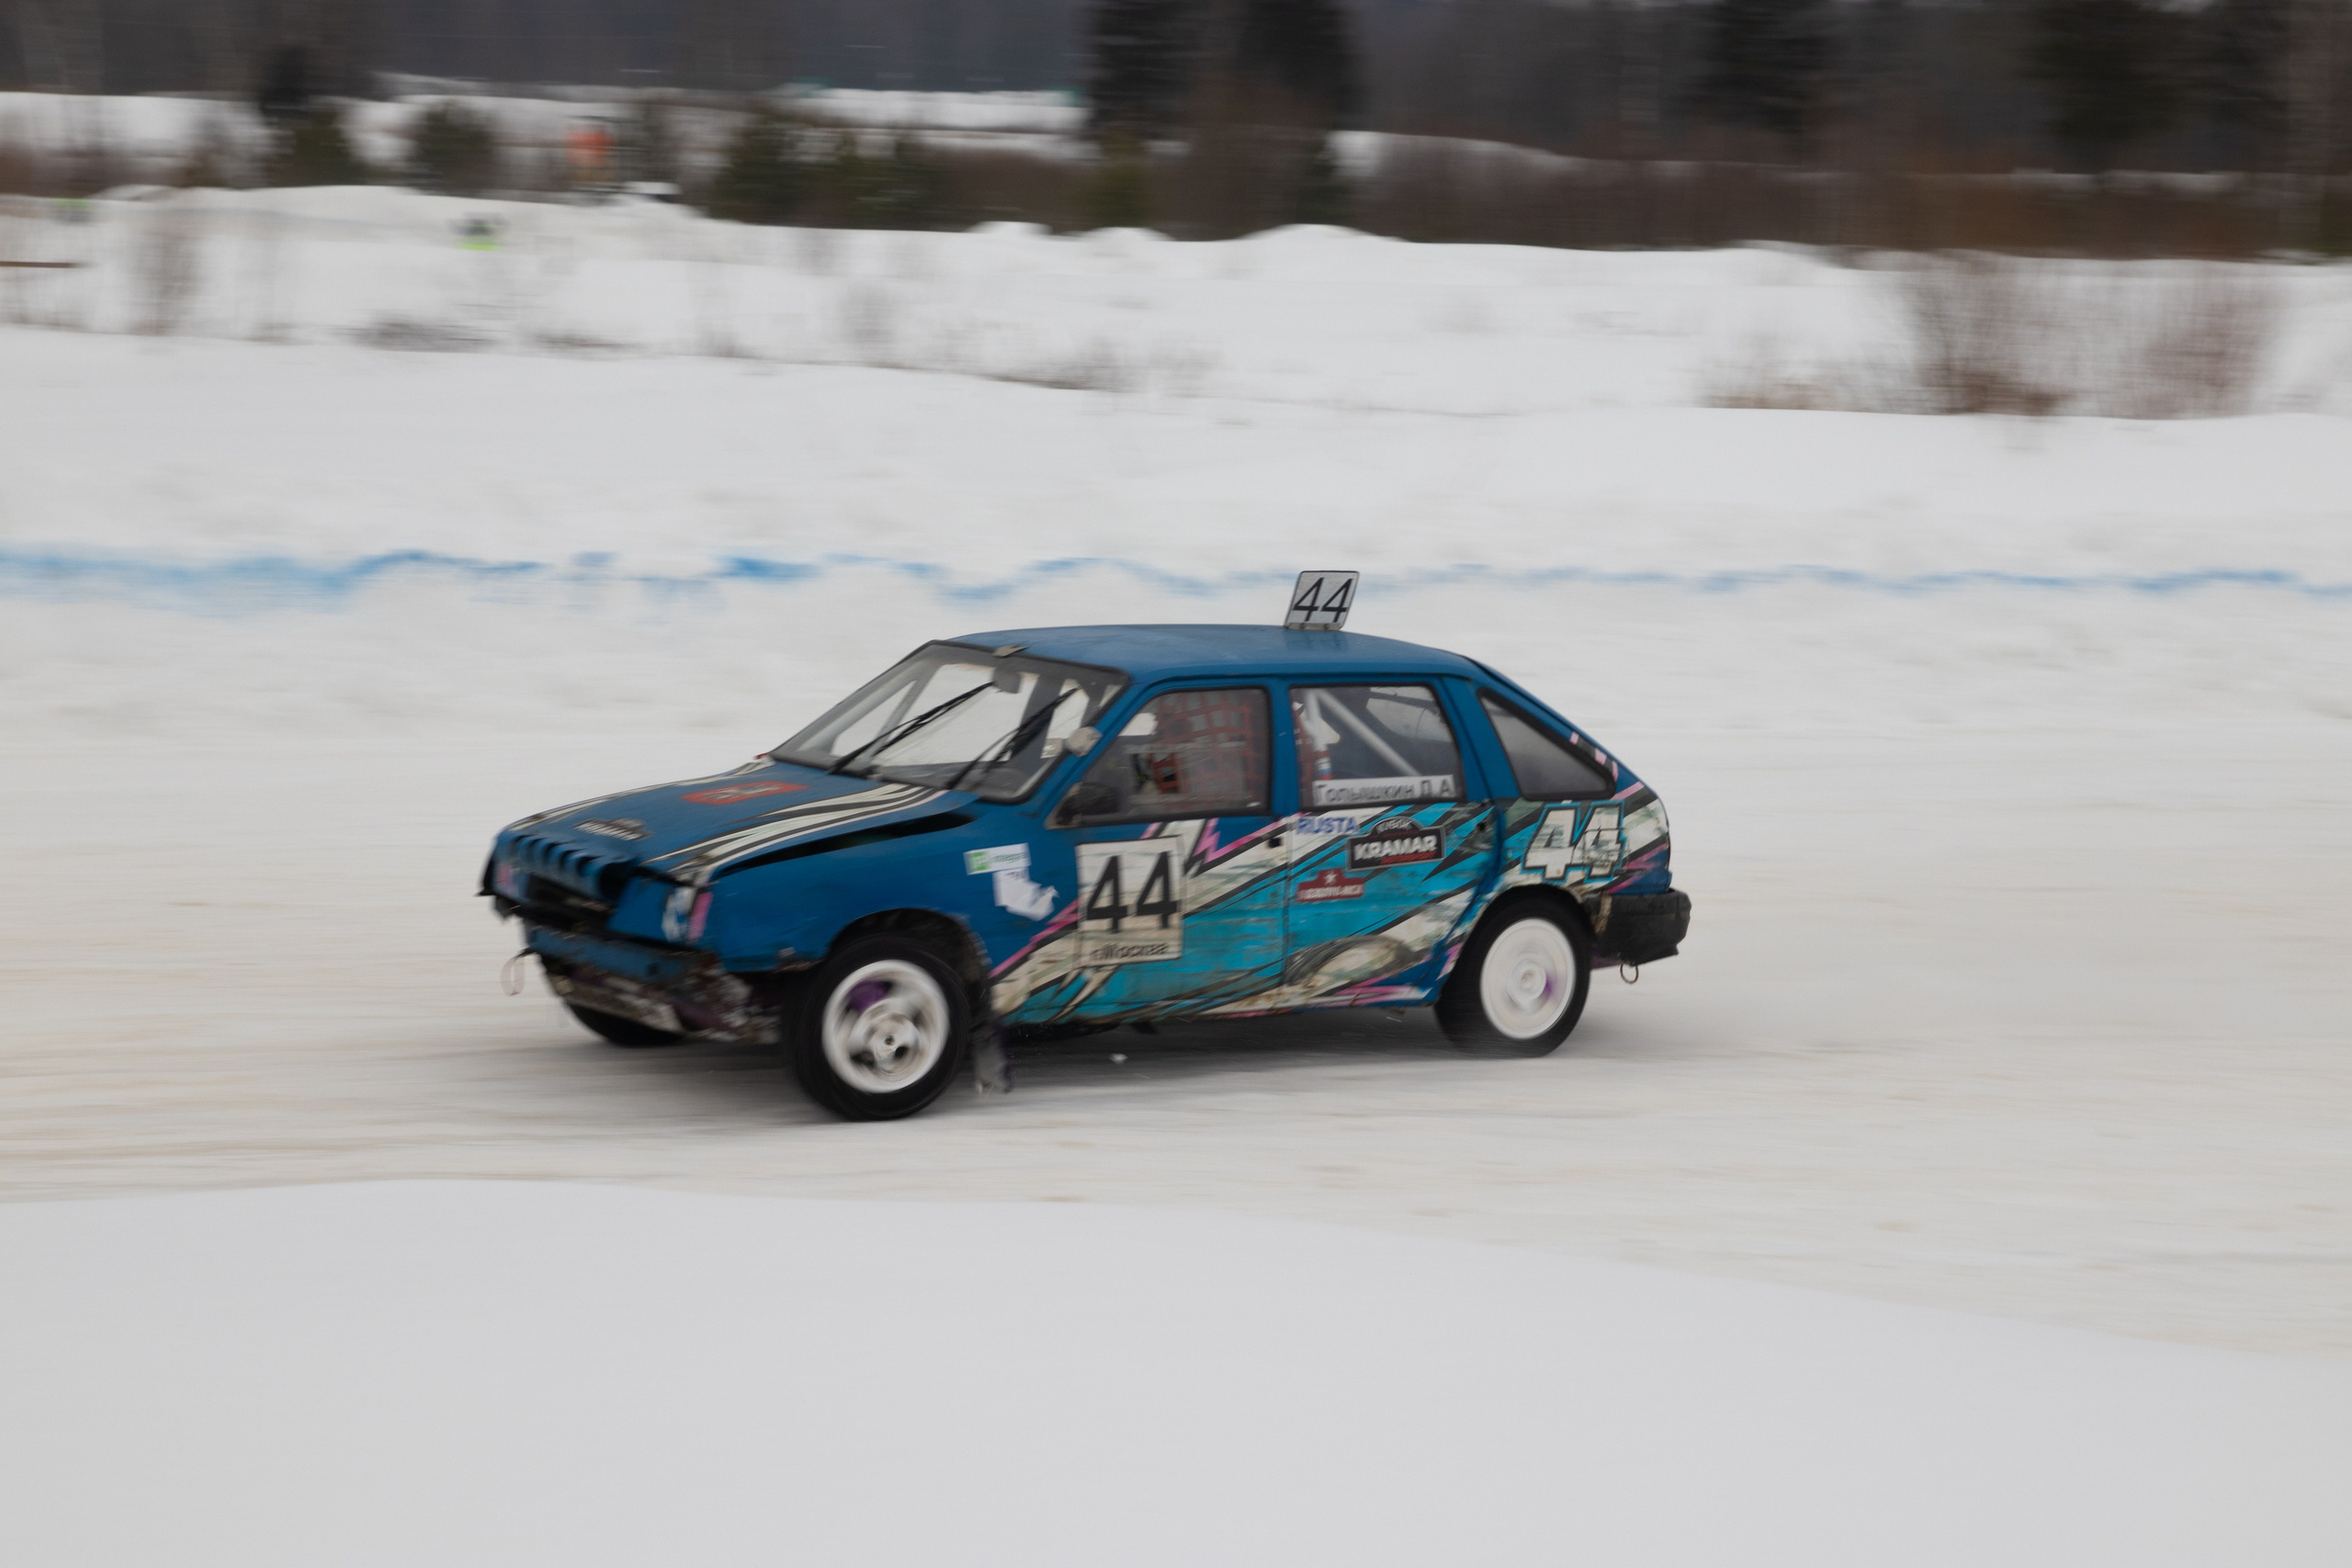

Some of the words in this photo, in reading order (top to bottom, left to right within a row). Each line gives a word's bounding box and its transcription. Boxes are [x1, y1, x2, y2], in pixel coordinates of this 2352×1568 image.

[1292, 576, 1353, 623] 44
[1296, 817, 1358, 835] RUSTA
[1353, 834, 1438, 862] KRAMAR
[1521, 802, 1624, 881] 44
[1086, 851, 1181, 933] 44
